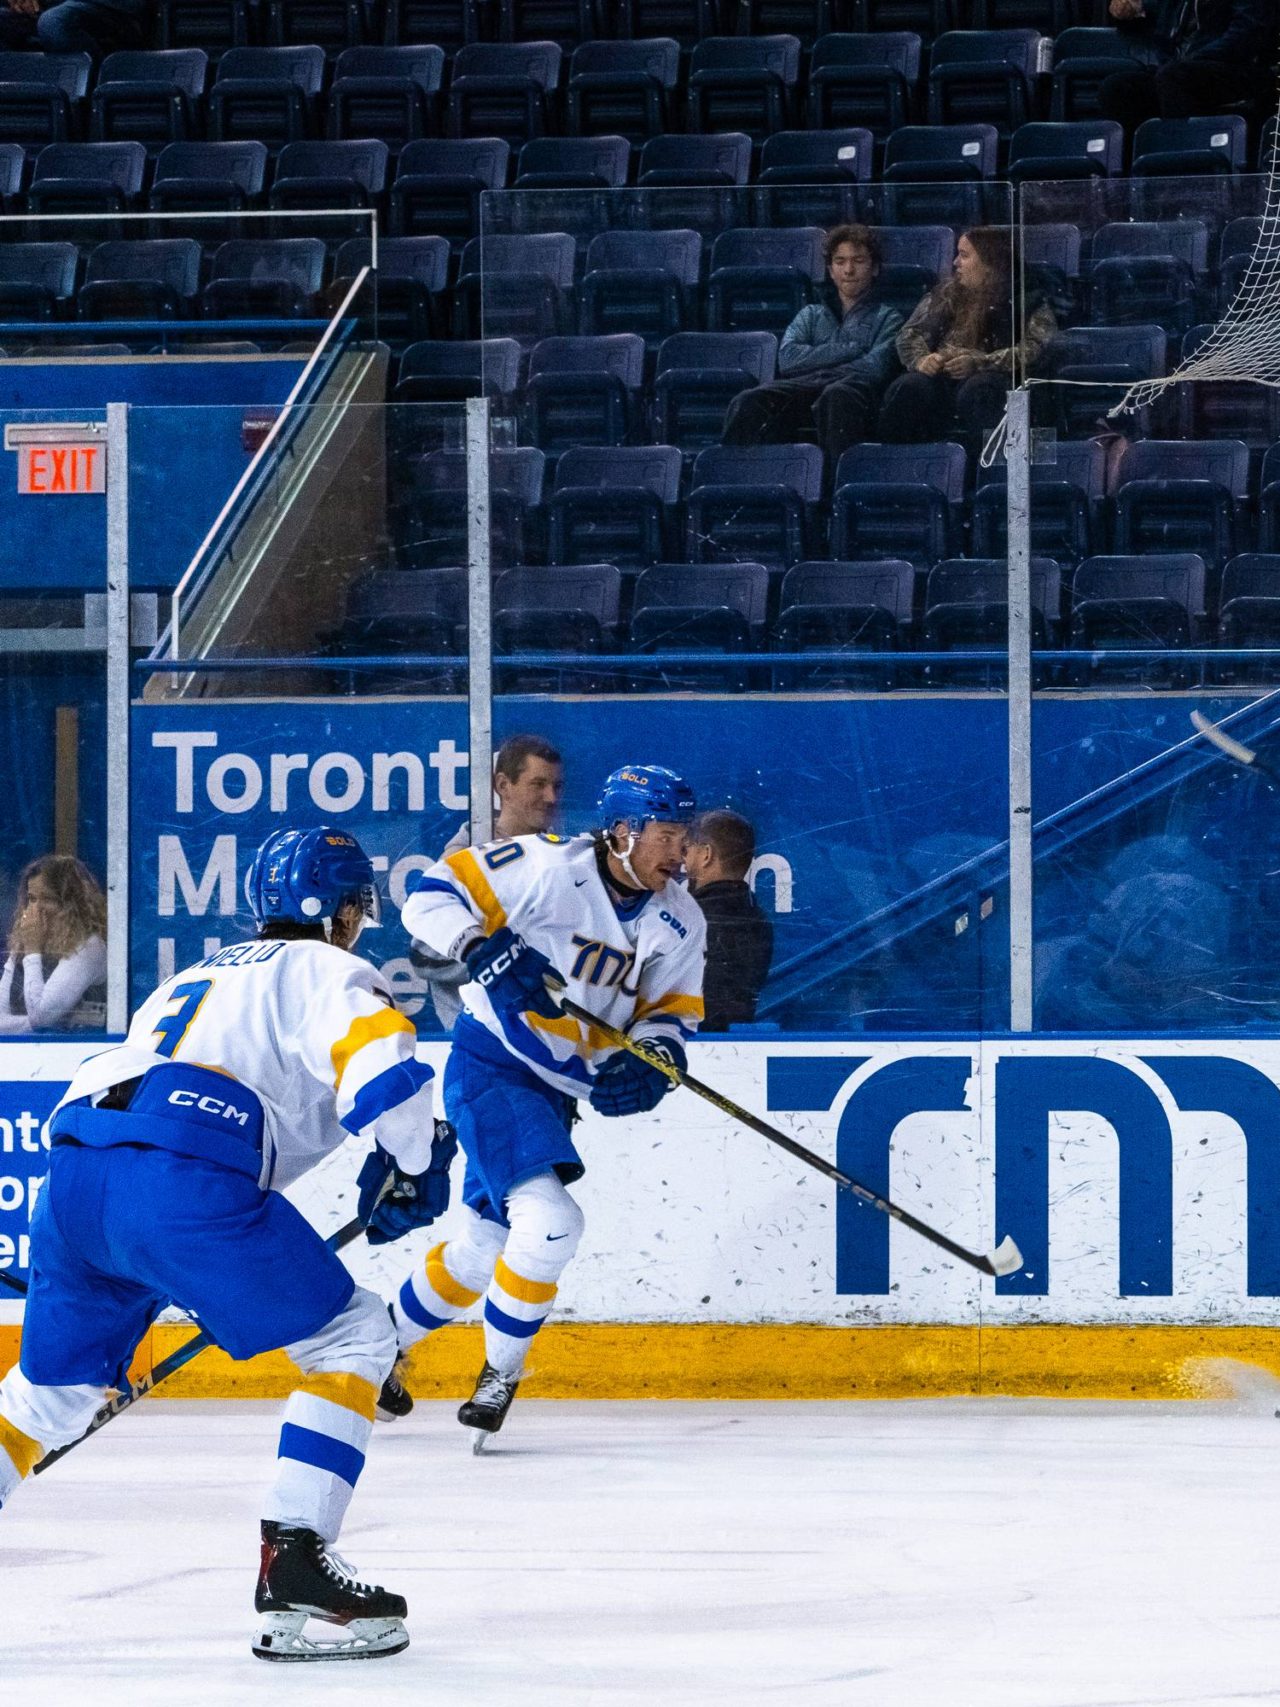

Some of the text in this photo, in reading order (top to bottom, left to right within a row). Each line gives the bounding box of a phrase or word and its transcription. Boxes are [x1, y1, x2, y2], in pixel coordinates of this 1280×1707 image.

[29, 448, 97, 492] EXIT
[152, 731, 500, 814] Toront
[476, 936, 530, 987] CCM
[168, 1089, 249, 1126] CCM
